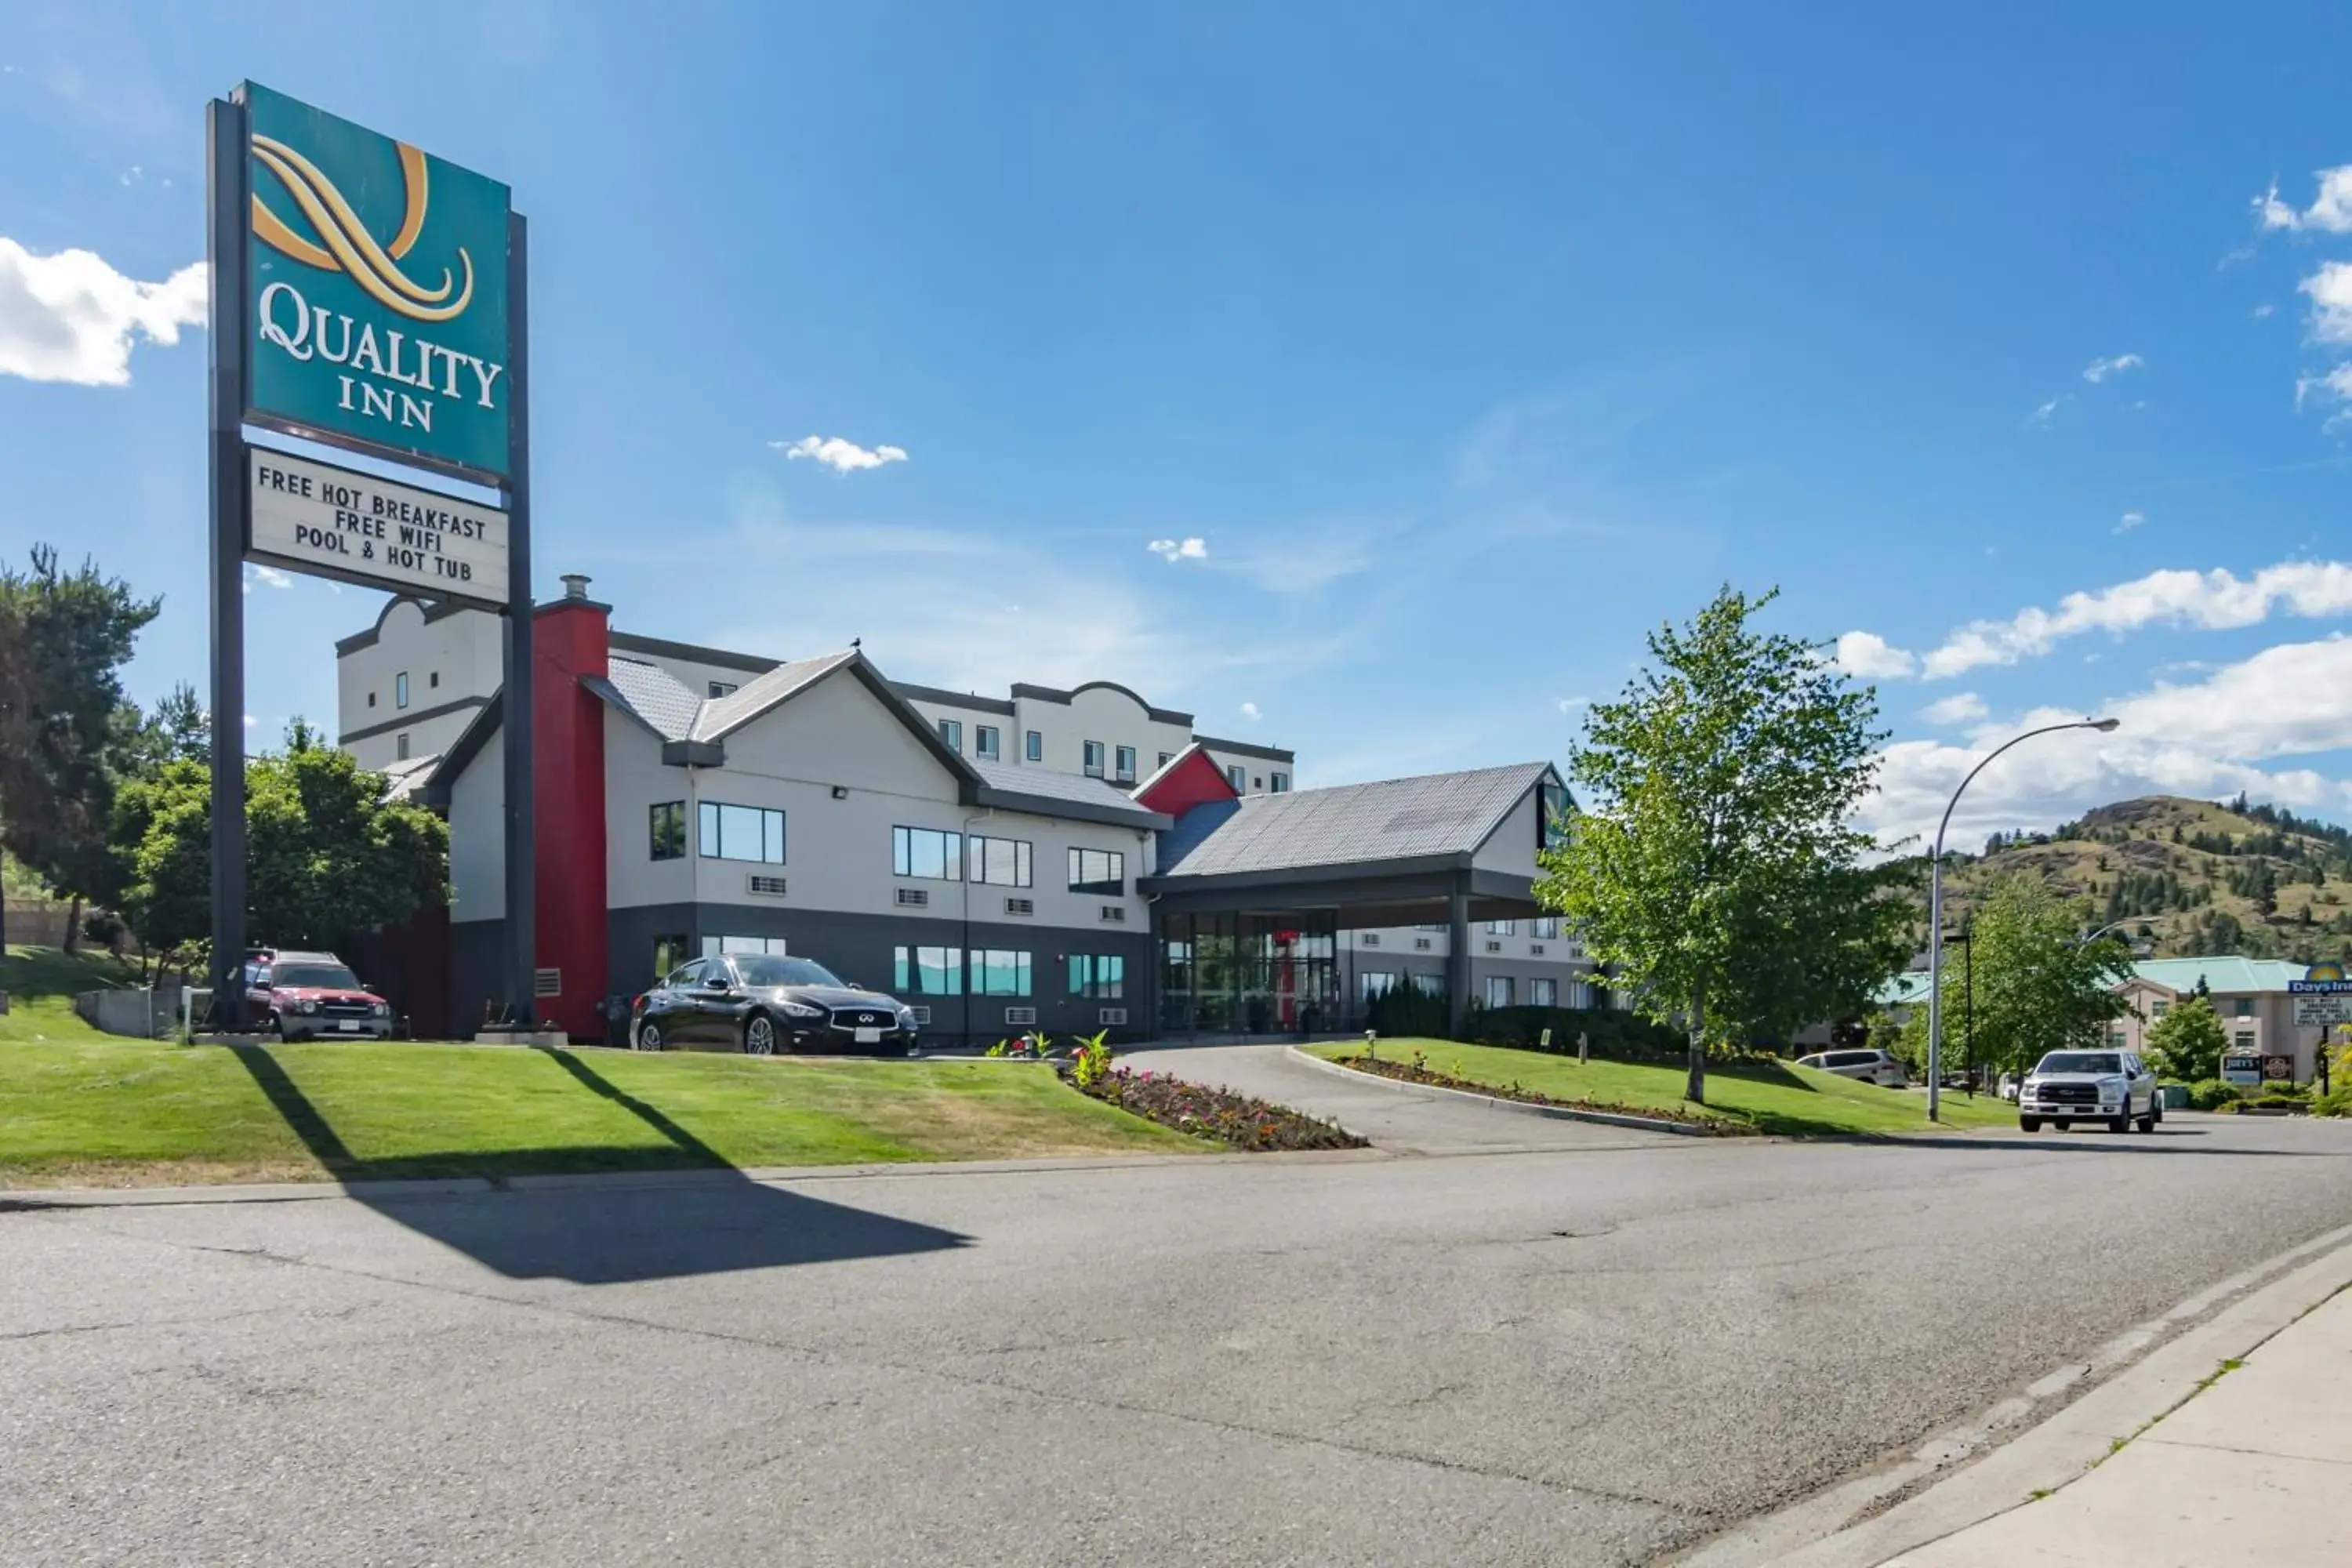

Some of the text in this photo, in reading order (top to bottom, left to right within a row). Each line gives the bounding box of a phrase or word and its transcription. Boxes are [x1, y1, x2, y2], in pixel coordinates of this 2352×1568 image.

[260, 282, 503, 409] QUALITY
[338, 376, 434, 433] INN
[259, 466, 486, 540] FREE HOT BREAKFAST
[335, 509, 441, 553] FREE WIFI
[295, 523, 472, 581] POOL & HOT TUB
[2292, 982, 2331, 993] Days
